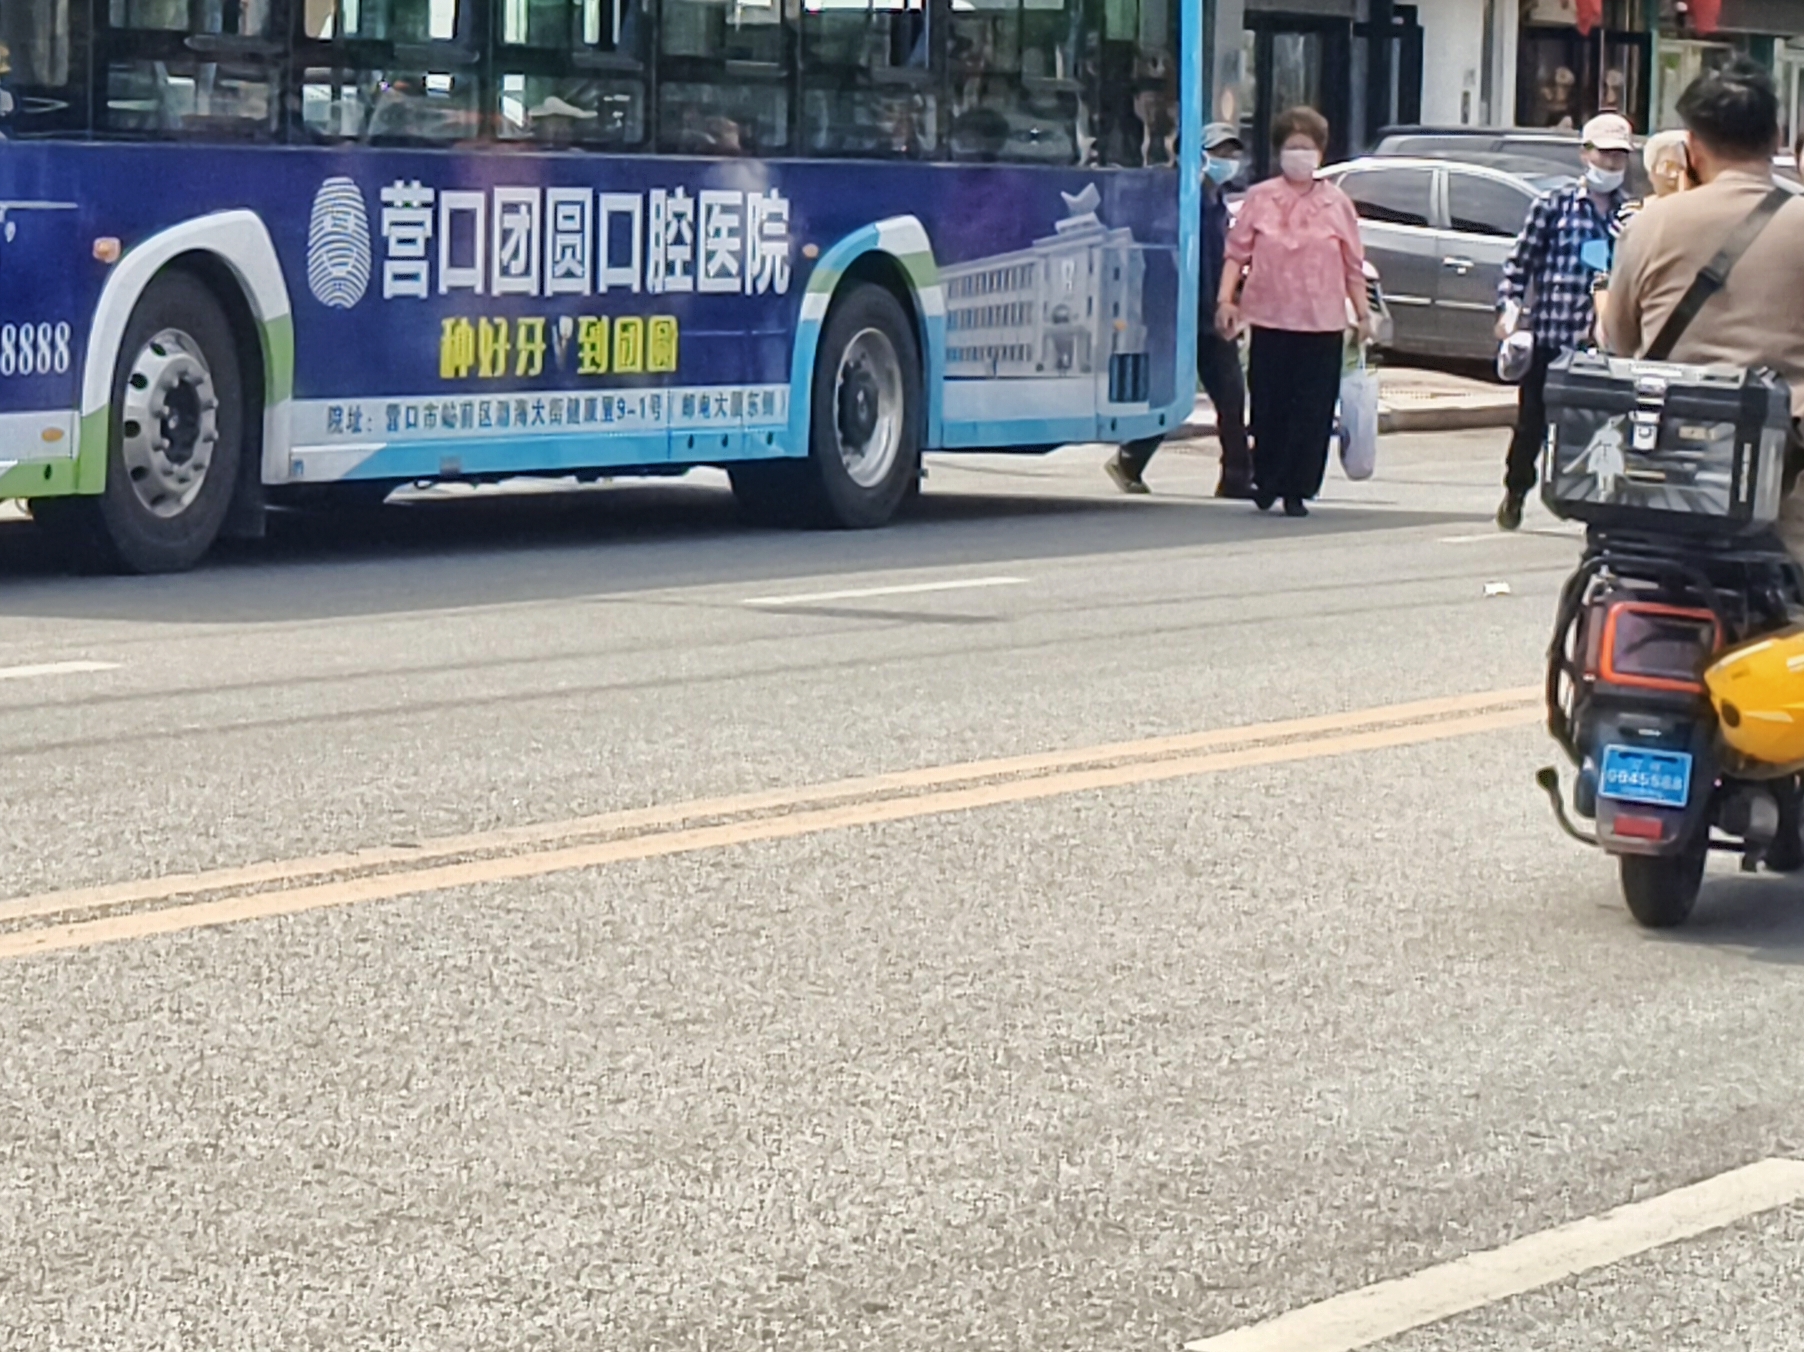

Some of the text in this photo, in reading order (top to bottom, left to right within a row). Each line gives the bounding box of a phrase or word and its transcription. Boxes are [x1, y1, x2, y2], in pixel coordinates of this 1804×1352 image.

[379, 179, 792, 300] 营口团圆口腔医院
[576, 314, 680, 375] 到团圆
